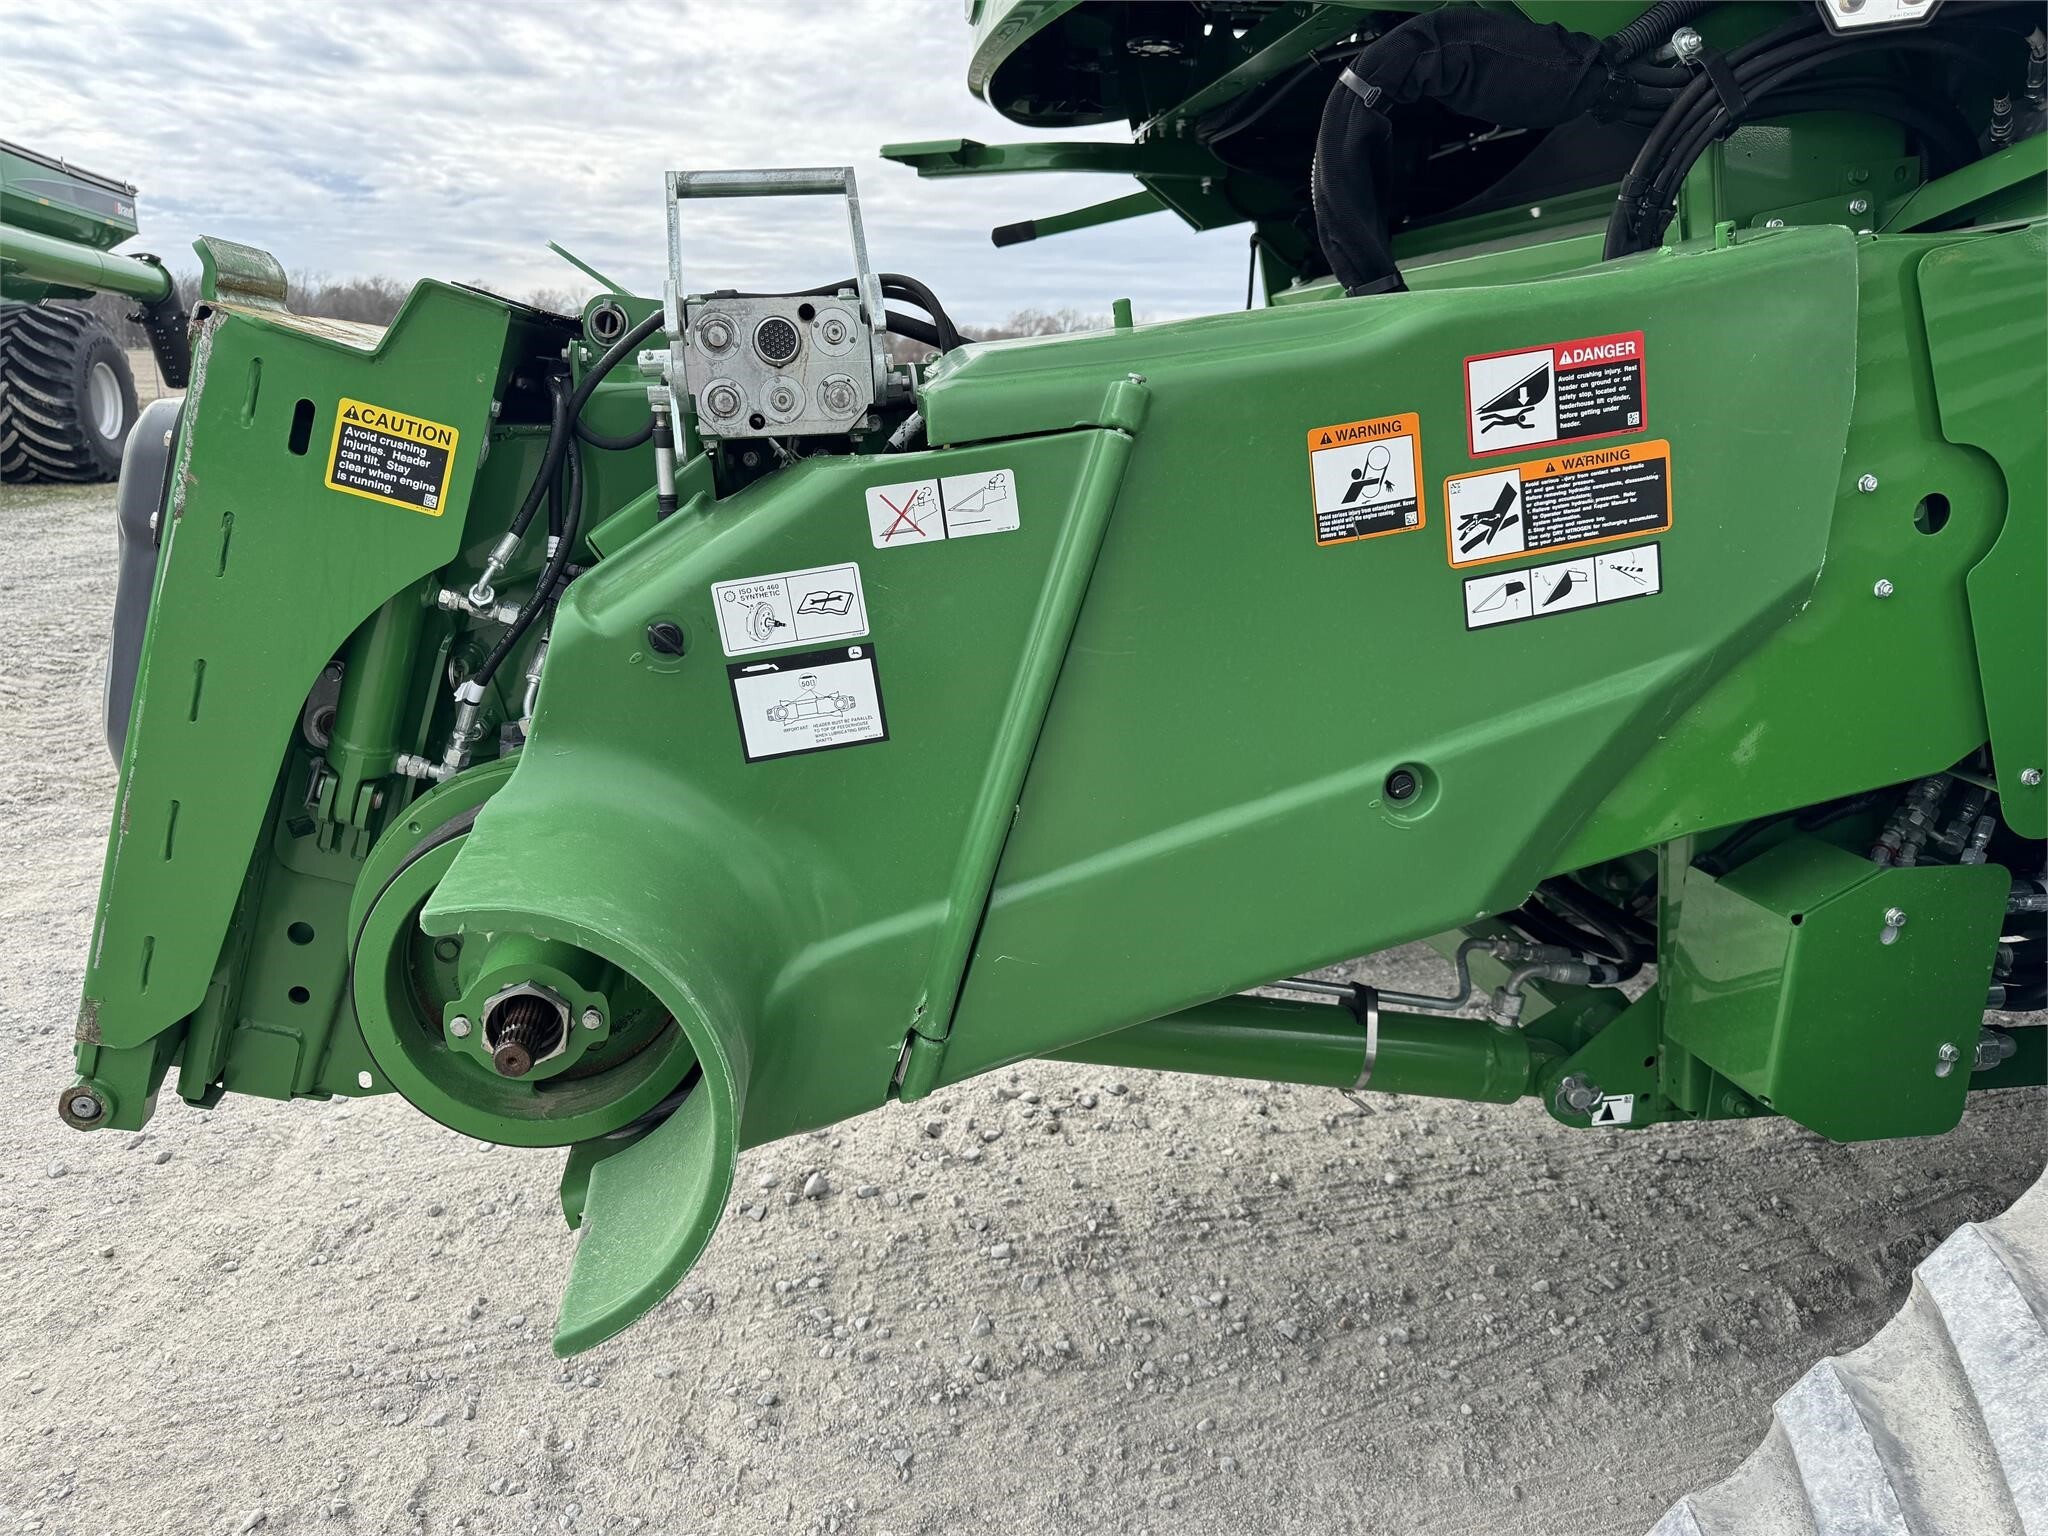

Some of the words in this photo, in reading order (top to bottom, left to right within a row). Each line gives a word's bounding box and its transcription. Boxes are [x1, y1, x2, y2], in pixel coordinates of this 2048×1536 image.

[1574, 341, 1635, 362] DANGER
[1577, 371, 1602, 379] crushing
[1591, 378, 1611, 387] ground
[1559, 393, 1576, 401] safety
[1596, 387, 1616, 395] located
[1559, 400, 1594, 410] feederhouse
[1607, 394, 1630, 403] cylinder,
[1581, 409, 1600, 417] getting
[362, 409, 451, 445] CAUTION
[1336, 420, 1401, 441] WARNING
[343, 437, 386, 456] injuries.
[392, 450, 430, 468] Header
[345, 427, 377, 442] Avoid
[379, 437, 427, 457] crushing
[341, 450, 360, 461] can
[364, 455, 380, 466] tilt.
[387, 461, 410, 476] Stay
[1562, 449, 1630, 470] WARNING
[337, 470, 346, 480] is
[350, 475, 393, 494] running.
[339, 461, 366, 473] clear
[369, 469, 397, 482] when
[400, 476, 435, 492] engine
[740, 590, 780, 601] SYNTHETIC
